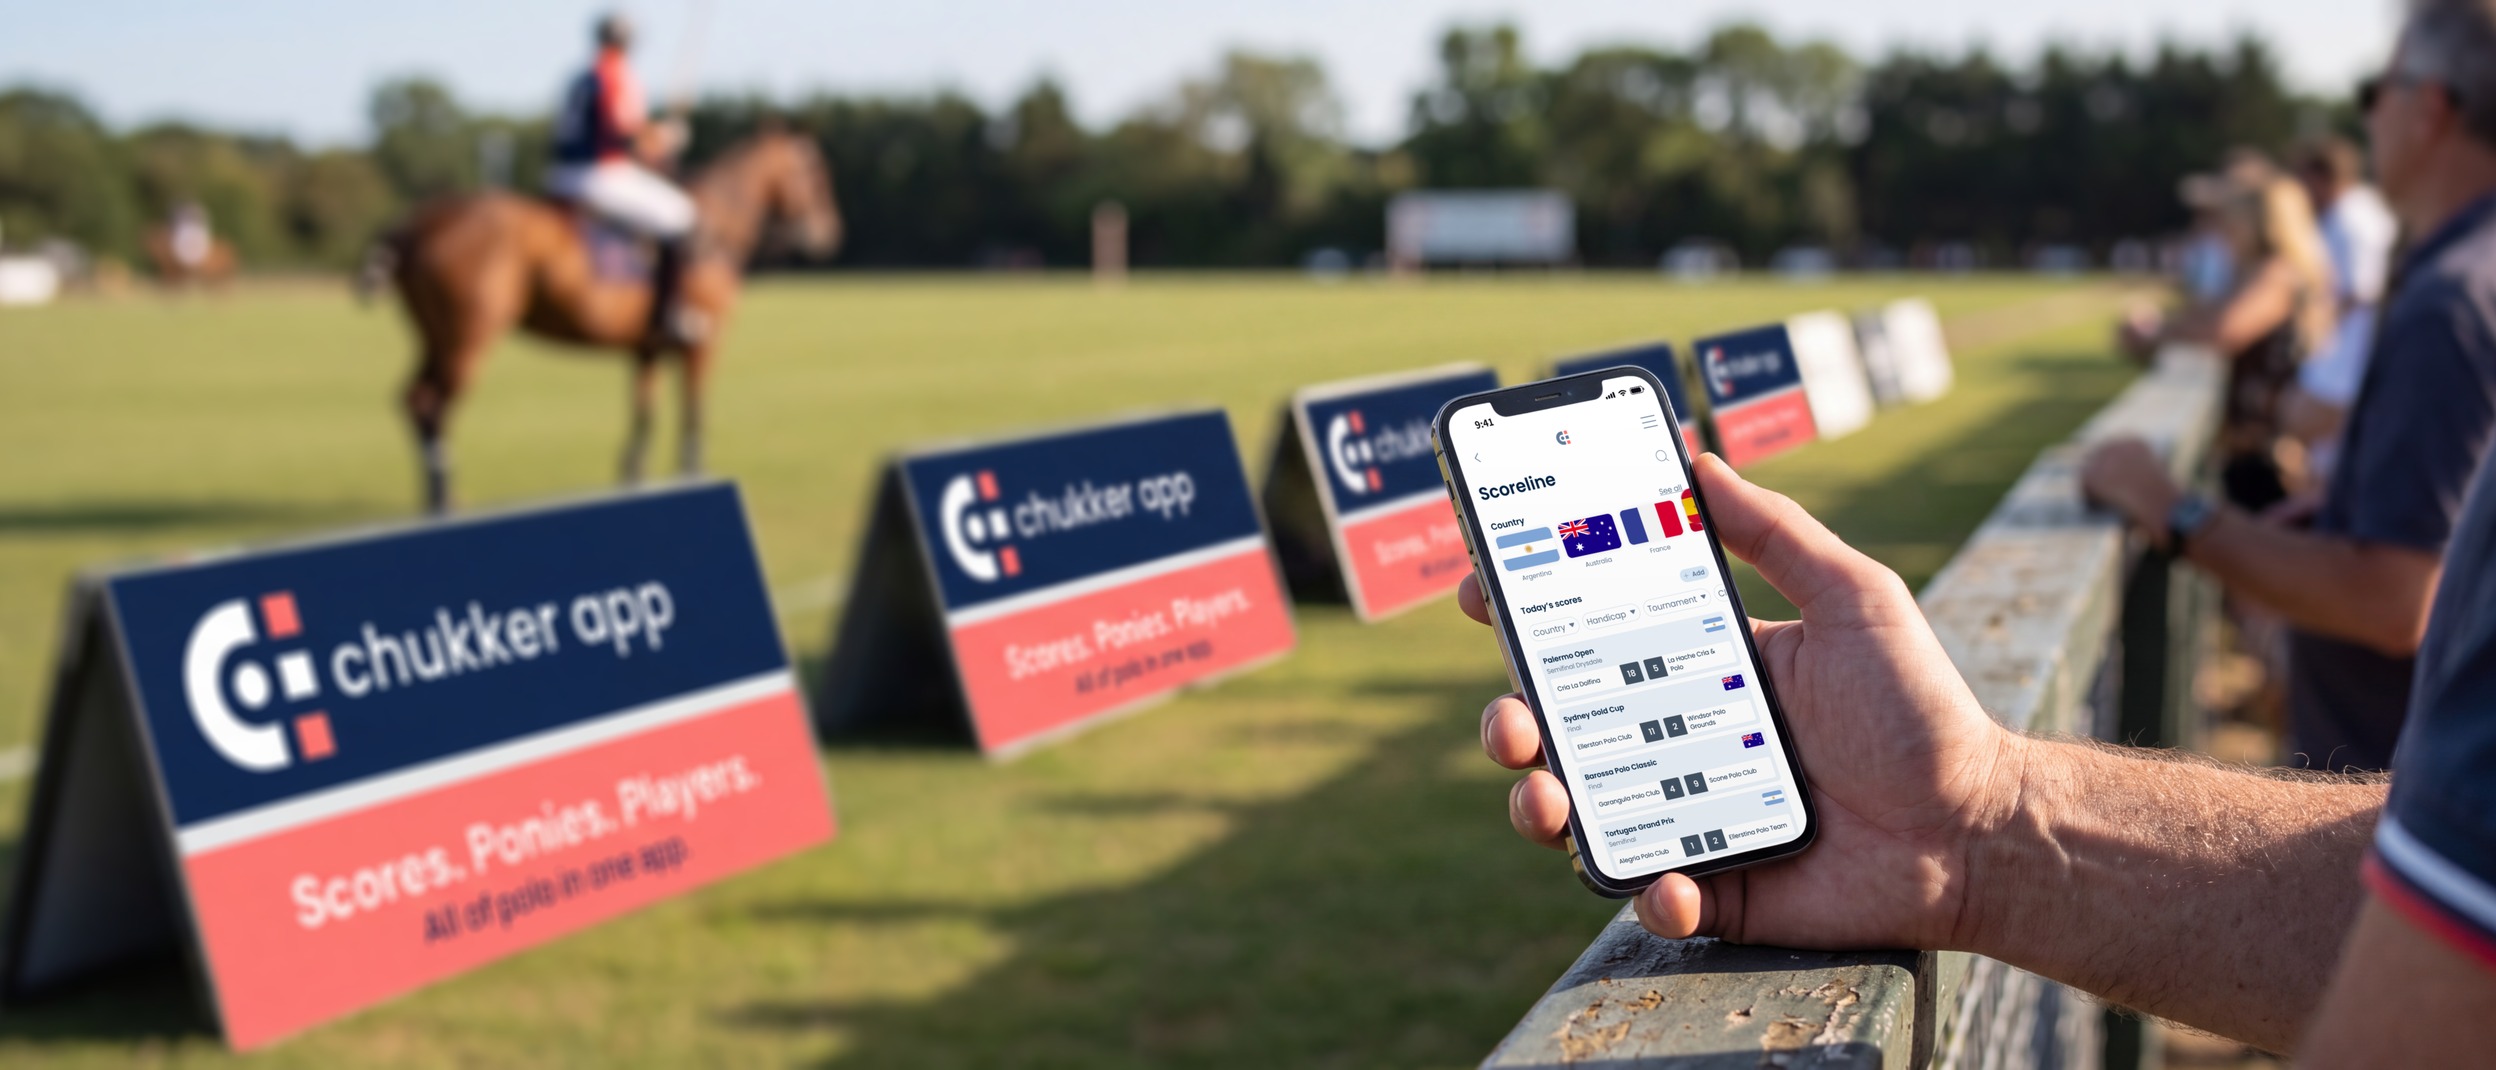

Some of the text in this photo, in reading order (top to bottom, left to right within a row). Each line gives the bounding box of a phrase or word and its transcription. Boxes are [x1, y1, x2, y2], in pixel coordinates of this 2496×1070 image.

[1474, 418, 1495, 430] 9:41
[1478, 474, 1556, 501] Scoreline
[1658, 484, 1683, 496] See all
[1014, 471, 1196, 537] chukker app
[1490, 517, 1525, 531] Country
[1649, 544, 1672, 554] France
[1585, 556, 1613, 568] Australia
[1522, 569, 1553, 582] Argentina
[1692, 568, 1706, 577] Add
[1520, 596, 1583, 615] Today's scores
[1647, 595, 1698, 613] Tournament
[1586, 610, 1627, 626] Handicap
[1533, 622, 1566, 638] Country
[330, 580, 675, 698] chukker app
[1542, 648, 1595, 665] Palermo Open
[1676, 653, 1696, 662] Hache
[1546, 657, 1603, 675] Semifinal Drysdale
[1652, 664, 1660, 672] 5
[1626, 669, 1637, 678] 18
[1563, 704, 1625, 724] Sydney Gold Cup
[1687, 708, 1726, 722] Windsor Polo
[1567, 724, 1582, 733] Final
[1690, 719, 1717, 730] Grounds
[1647, 727, 1656, 736] 11
[1603, 736, 1617, 745] Polo
[1617, 733, 1633, 742] Club
[1584, 759, 1658, 781] Barossa Polo Classic
[1709, 768, 1757, 783] Scone Polo Club
[1588, 782, 1603, 791] Final
[1669, 785, 1676, 793] 4
[1598, 788, 1660, 808] Garangula Polo Club
[1605, 817, 1675, 838] Tortugas Grand Prix
[1728, 822, 1788, 841] Ellerstina Polo Team
[290, 755, 762, 929] Scores. Ponies. Players.
[1608, 836, 1637, 848] Semifinal
[1690, 842, 1695, 850] 1
[1712, 837, 1719, 845] 2
[1641, 852, 1655, 860] Polo
[1655, 849, 1670, 857] Club
[423, 905, 461, 945] All
[463, 897, 493, 933] of
[495, 876, 557, 931] polo
[560, 868, 583, 899] in
[587, 850, 635, 890] one
